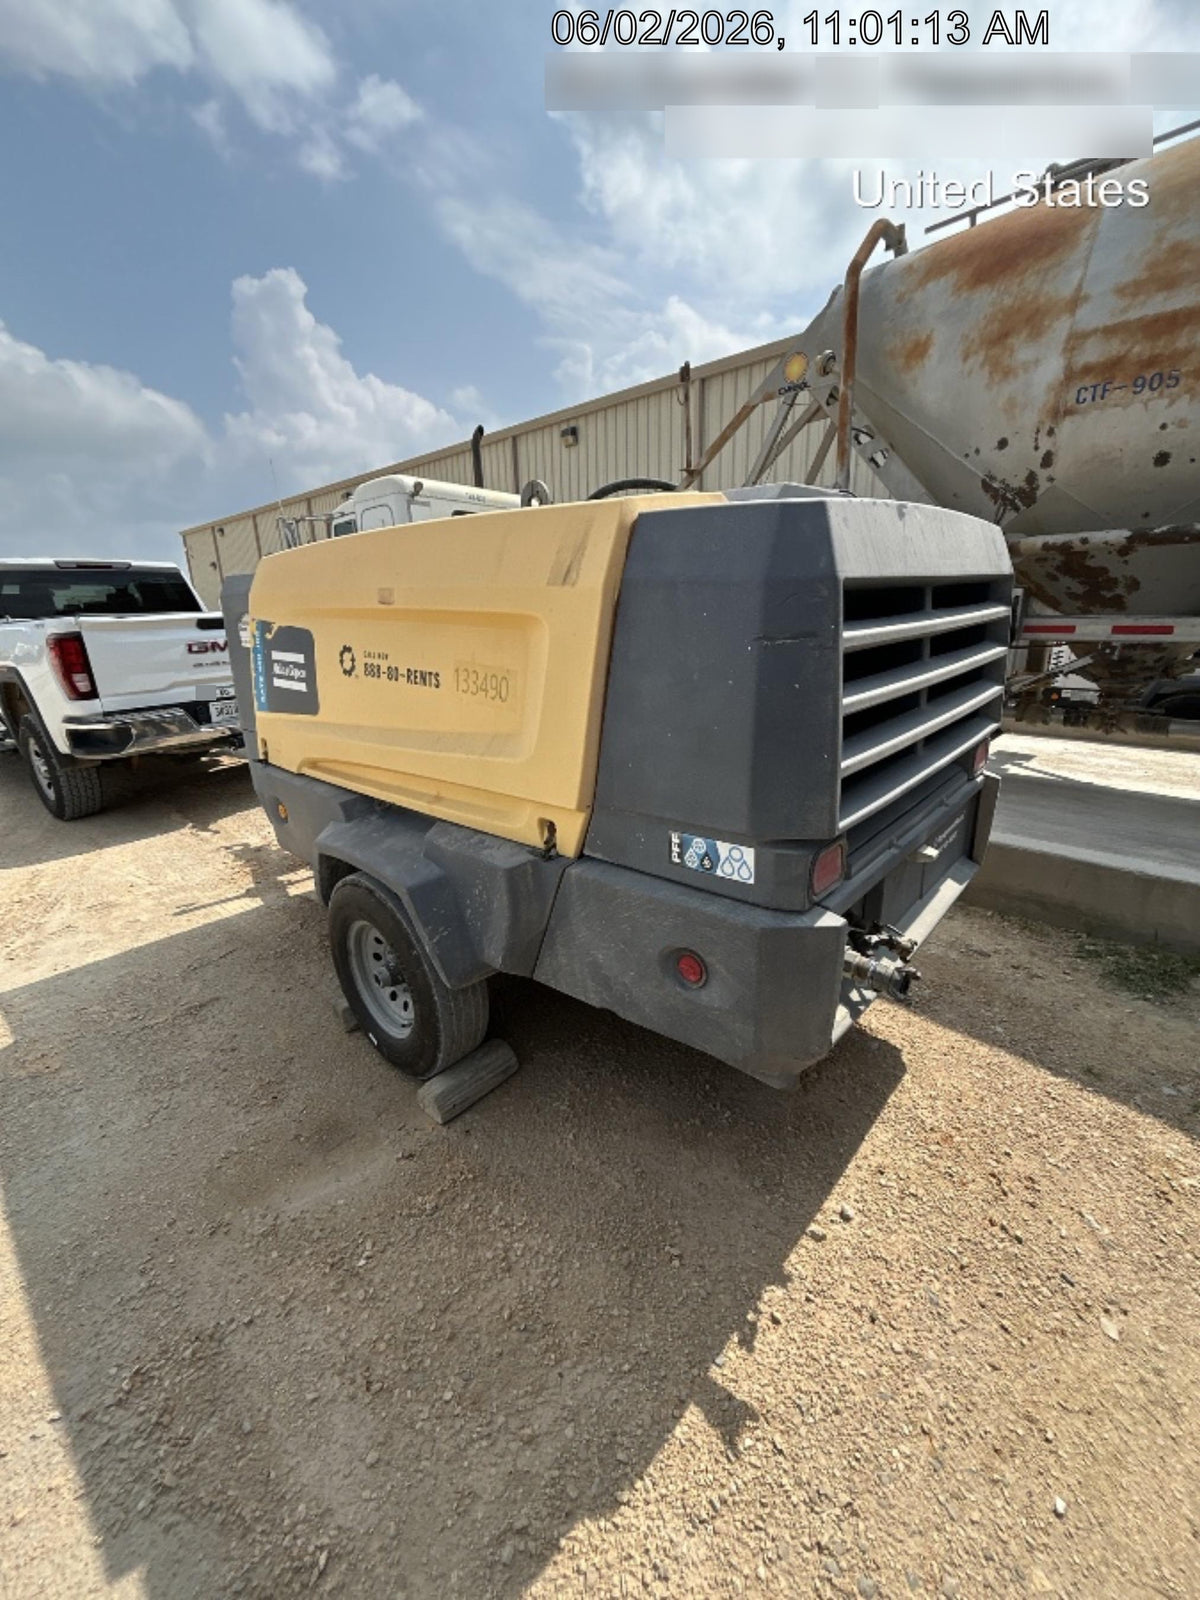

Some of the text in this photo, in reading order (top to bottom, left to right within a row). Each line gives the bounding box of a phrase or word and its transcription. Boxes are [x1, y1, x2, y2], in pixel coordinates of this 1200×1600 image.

[1075, 369, 1182, 405] CTF-905
[188, 641, 228, 653] GM
[363, 663, 441, 688] 888-80-RENTS
[454, 667, 510, 703] 133490
